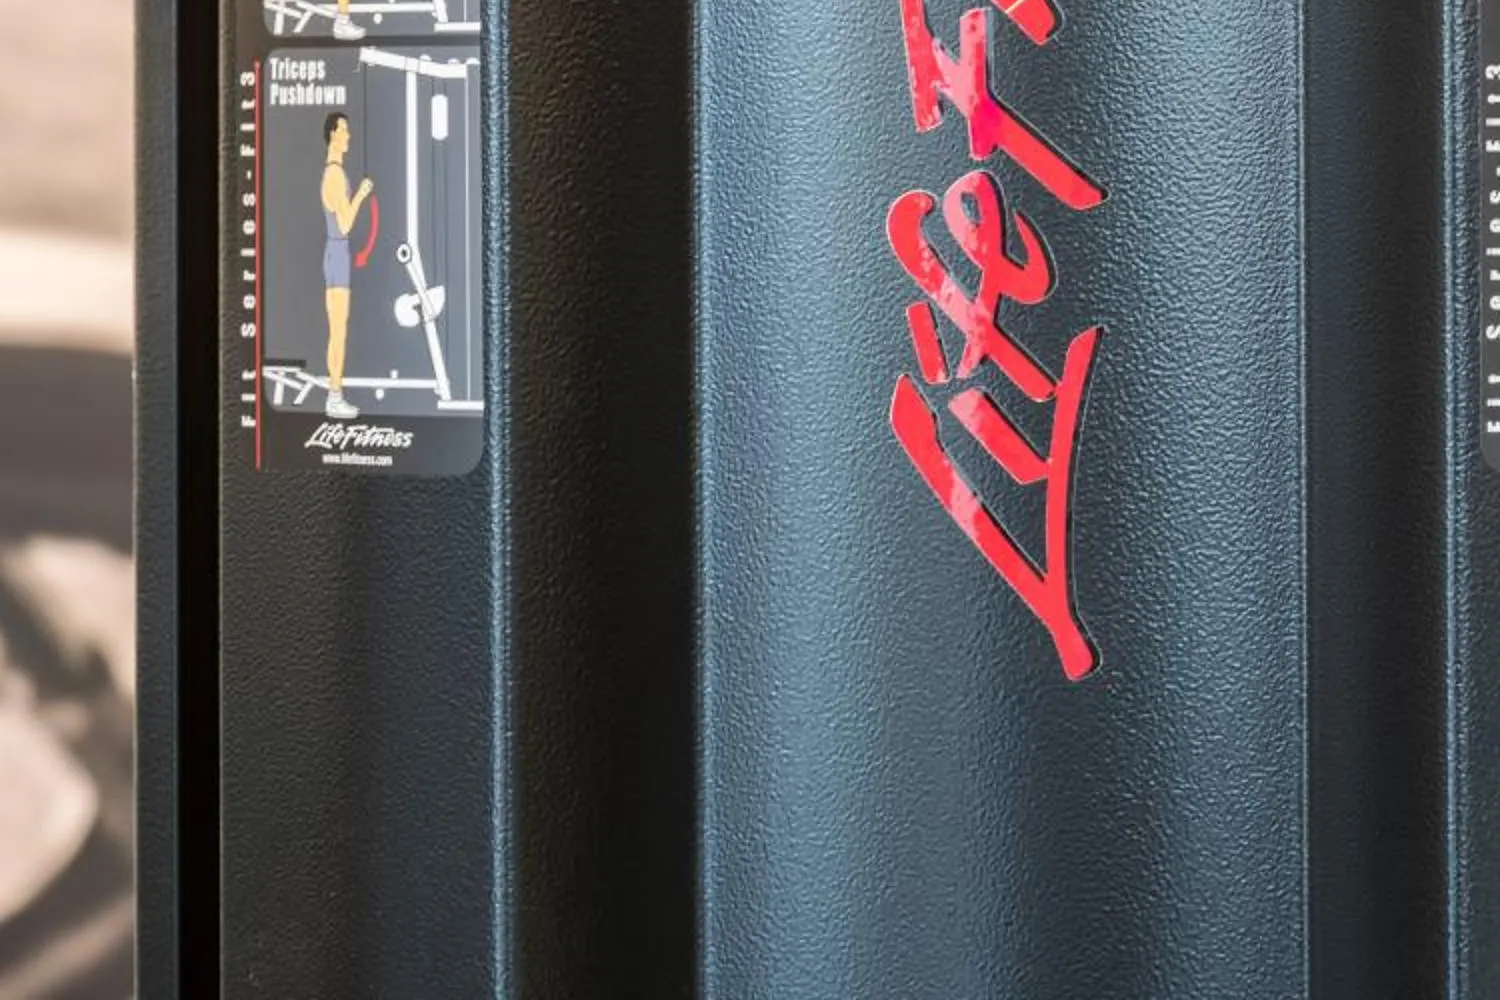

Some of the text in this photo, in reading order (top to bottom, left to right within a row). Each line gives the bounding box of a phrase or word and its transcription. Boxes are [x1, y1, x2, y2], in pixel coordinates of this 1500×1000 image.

[268, 57, 327, 82] Triceps
[268, 80, 348, 106] Pushdown
[321, 452, 394, 467] www.lifefitness.com
